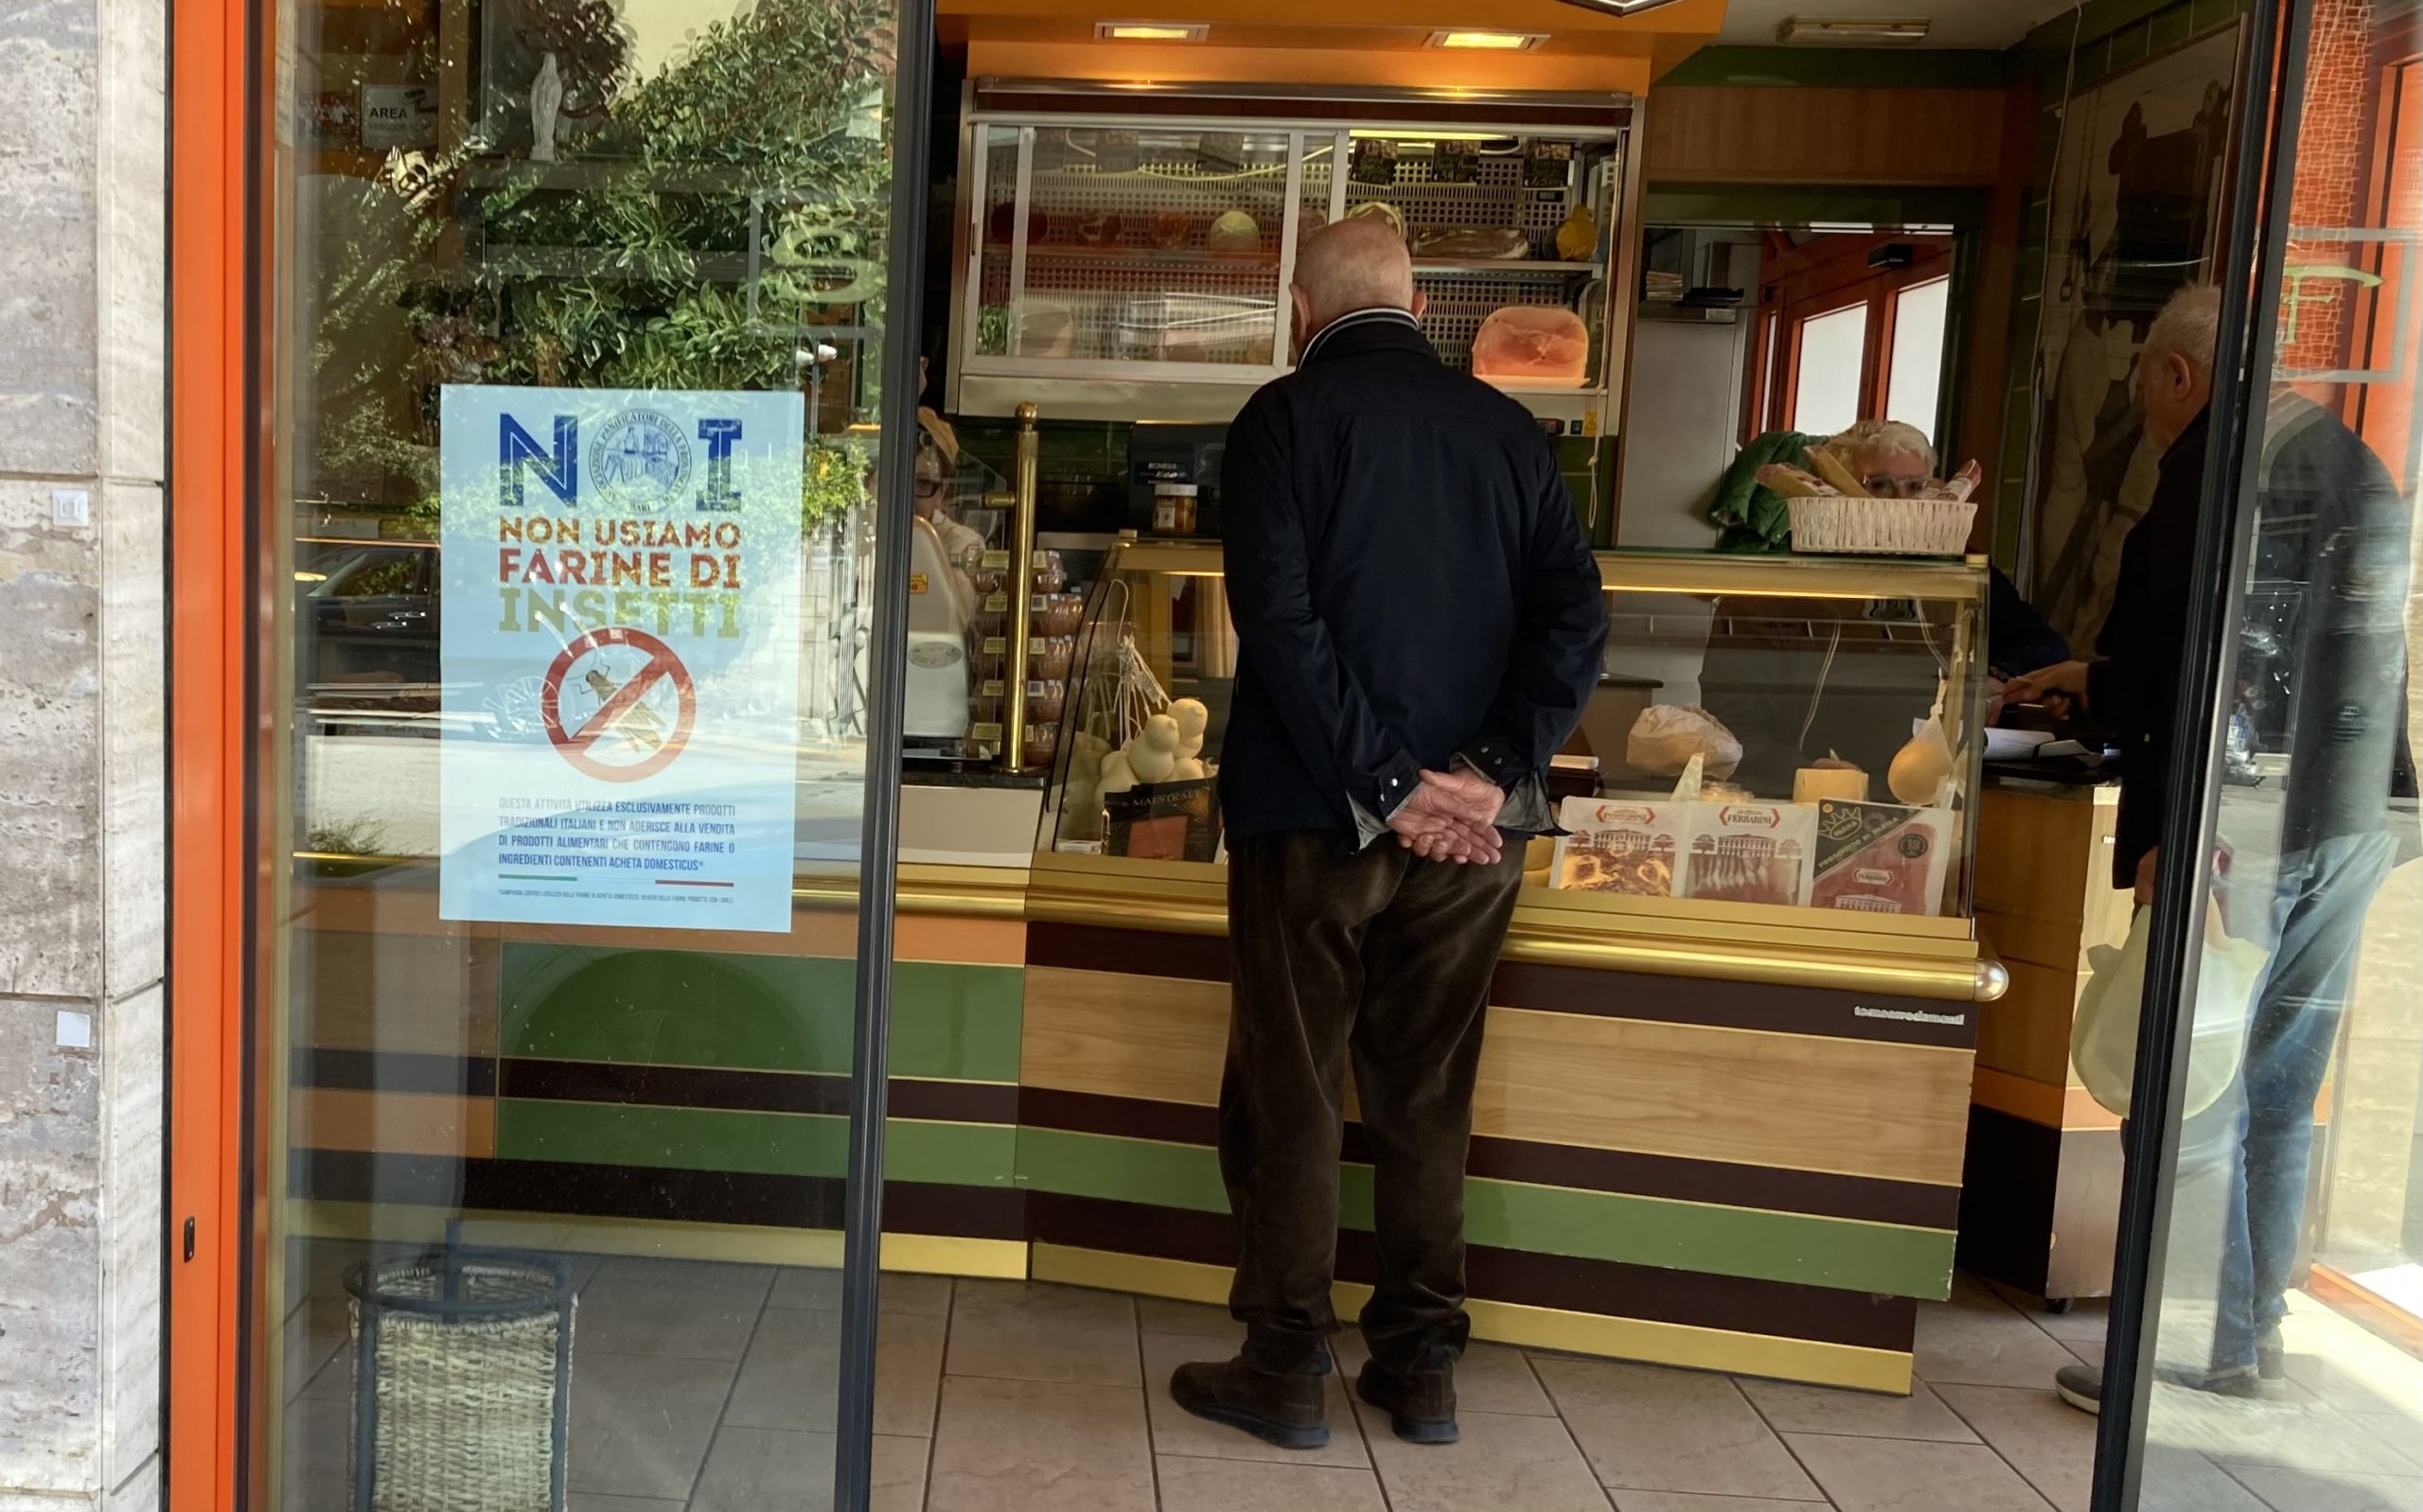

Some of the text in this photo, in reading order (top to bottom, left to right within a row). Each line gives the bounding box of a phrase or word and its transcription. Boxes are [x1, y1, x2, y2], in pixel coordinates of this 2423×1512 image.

[370, 107, 408, 119] AREA
[500, 517, 741, 549] NON USIAMO
[500, 548, 740, 589] FARINE DI
[499, 588, 740, 638] INSETTI
[499, 798, 735, 817] QUESTA ATTIVITÀ UTILIZZA ESCLUSIVAMENTE PRODOTTI
[499, 817, 735, 835] TRADIZIONALI ITALIANI E NON ADERISCE ALLA VENDITA
[1726, 814, 1772, 825] FERRARINI
[499, 835, 735, 853] DI PRODOTTI ALIMENTARI CHE CONTENGONO FARINE O
[499, 853, 552, 866] INGREDIENTI
[554, 855, 607, 868] CONTENENTI
[610, 857, 643, 869] ACHETA
